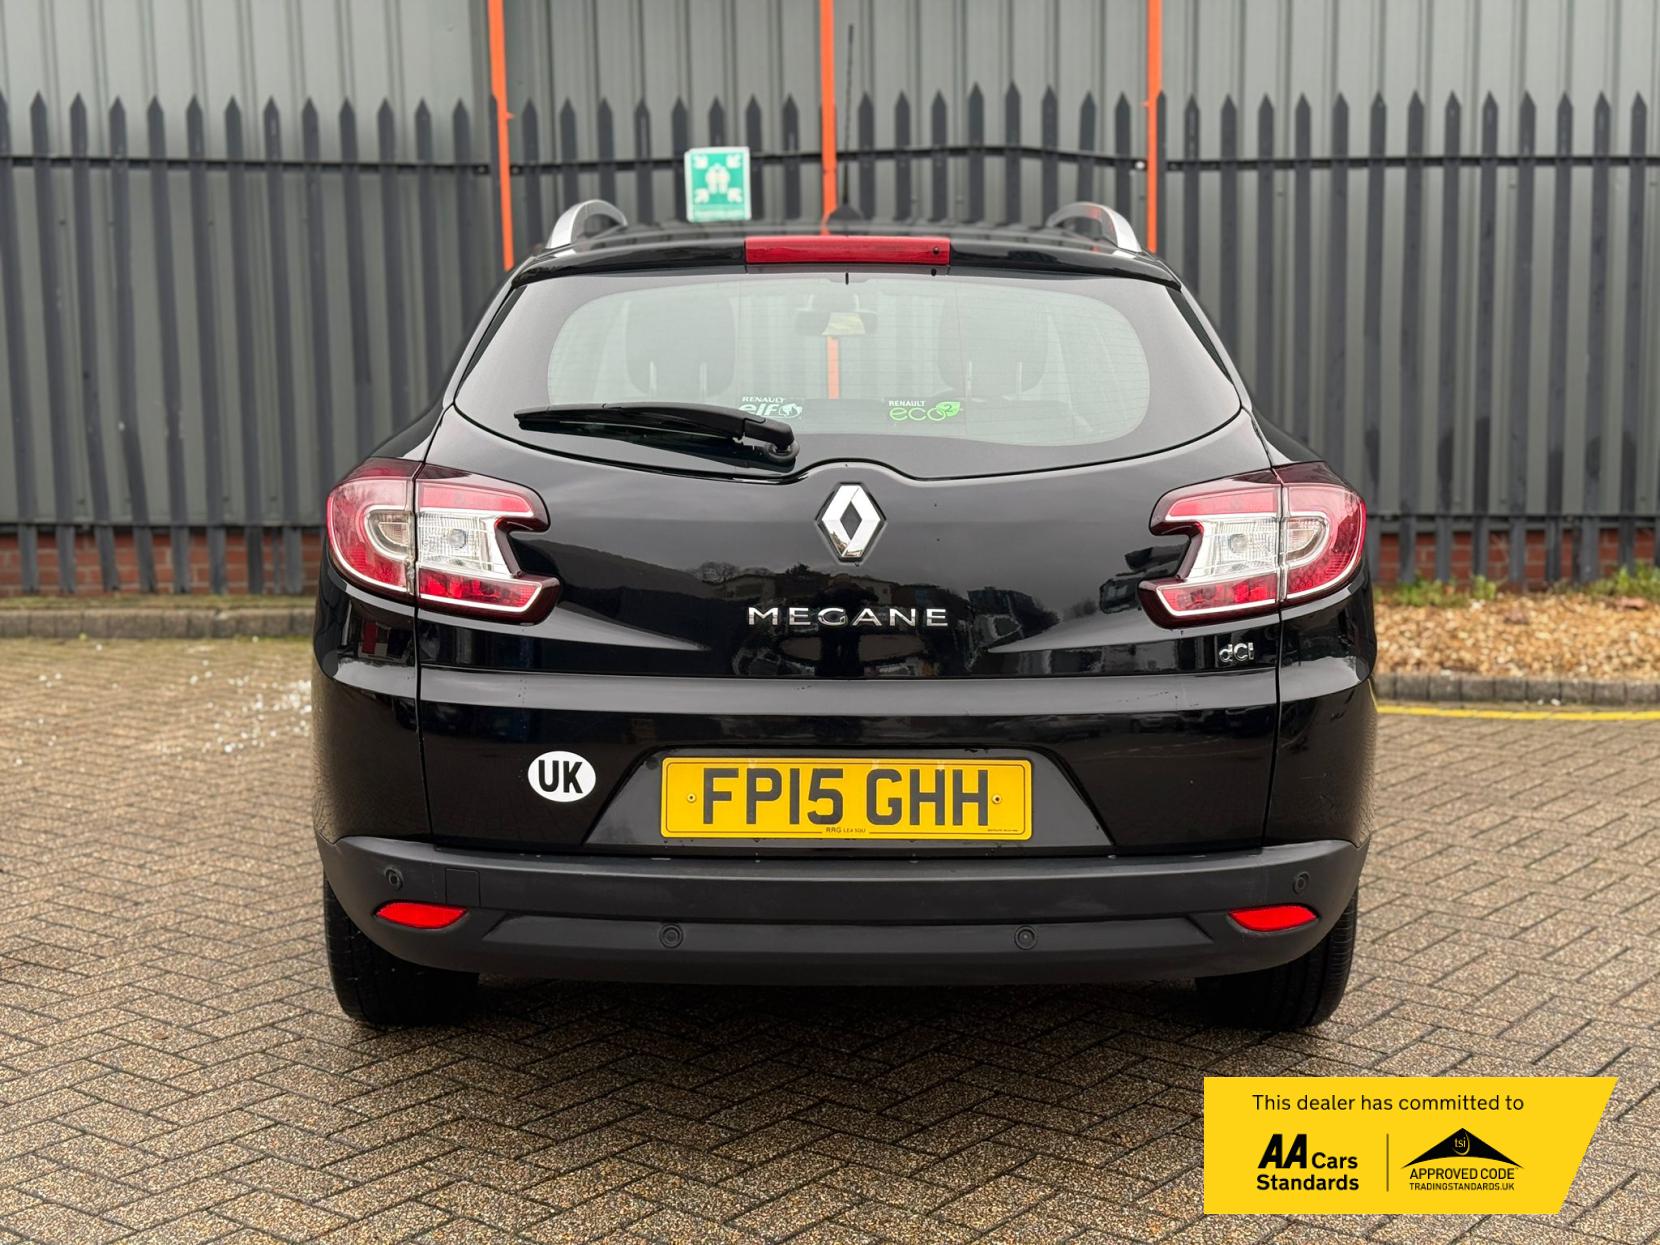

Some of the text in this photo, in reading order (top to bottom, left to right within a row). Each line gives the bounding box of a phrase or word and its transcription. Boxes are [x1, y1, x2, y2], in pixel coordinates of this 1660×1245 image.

[748, 607, 948, 627] MEGANE
[539, 761, 582, 793] UK
[703, 768, 988, 826] FP15 GHH
